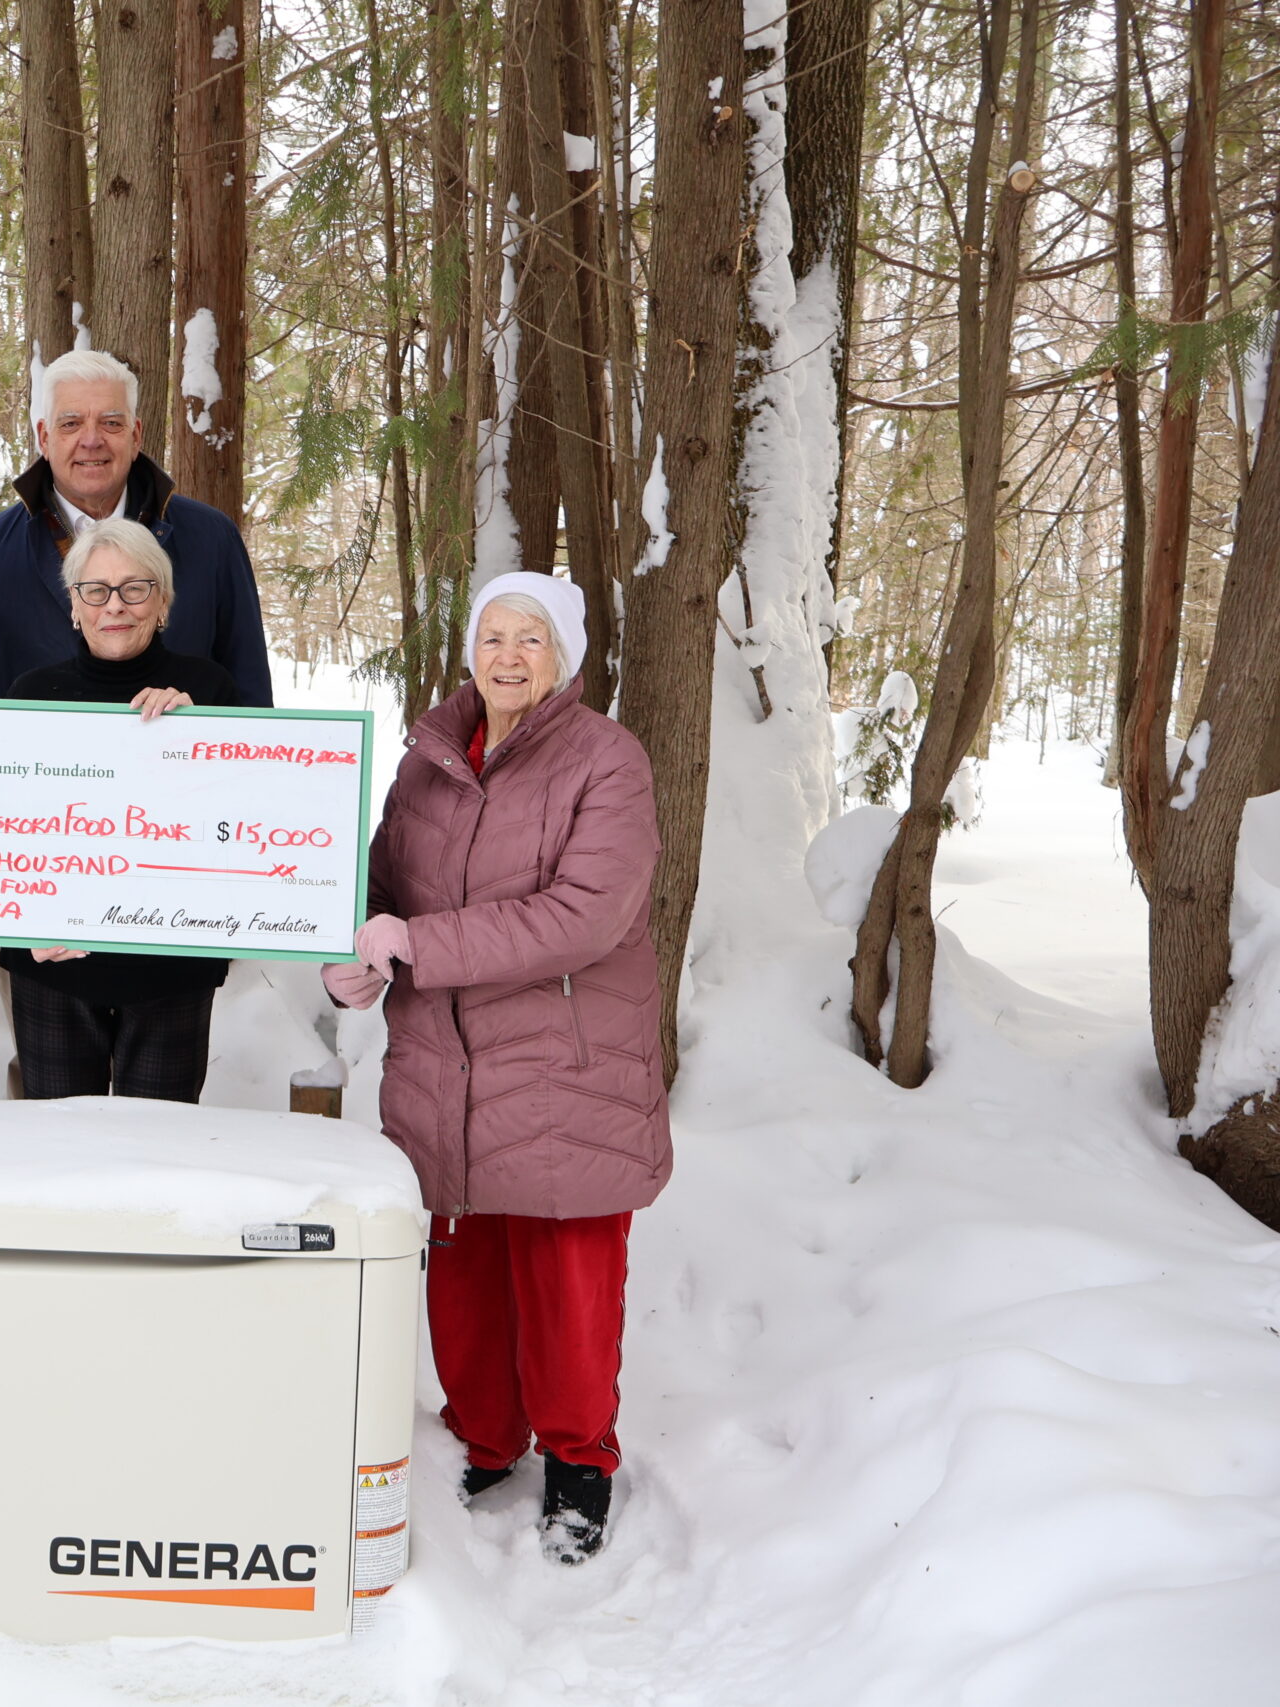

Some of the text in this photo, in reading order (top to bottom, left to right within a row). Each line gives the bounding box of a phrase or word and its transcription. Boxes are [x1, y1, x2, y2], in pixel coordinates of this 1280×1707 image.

[162, 751, 189, 761] DATE
[34, 762, 115, 779] Foundation
[0, 878, 58, 896] FUND
[298, 878, 338, 887] DOLLARS
[67, 905, 318, 937] PER Muskoka Community Foundation
[248, 1232, 330, 1242] Guardian 26kW
[49, 1536, 317, 1582] GENERAC
